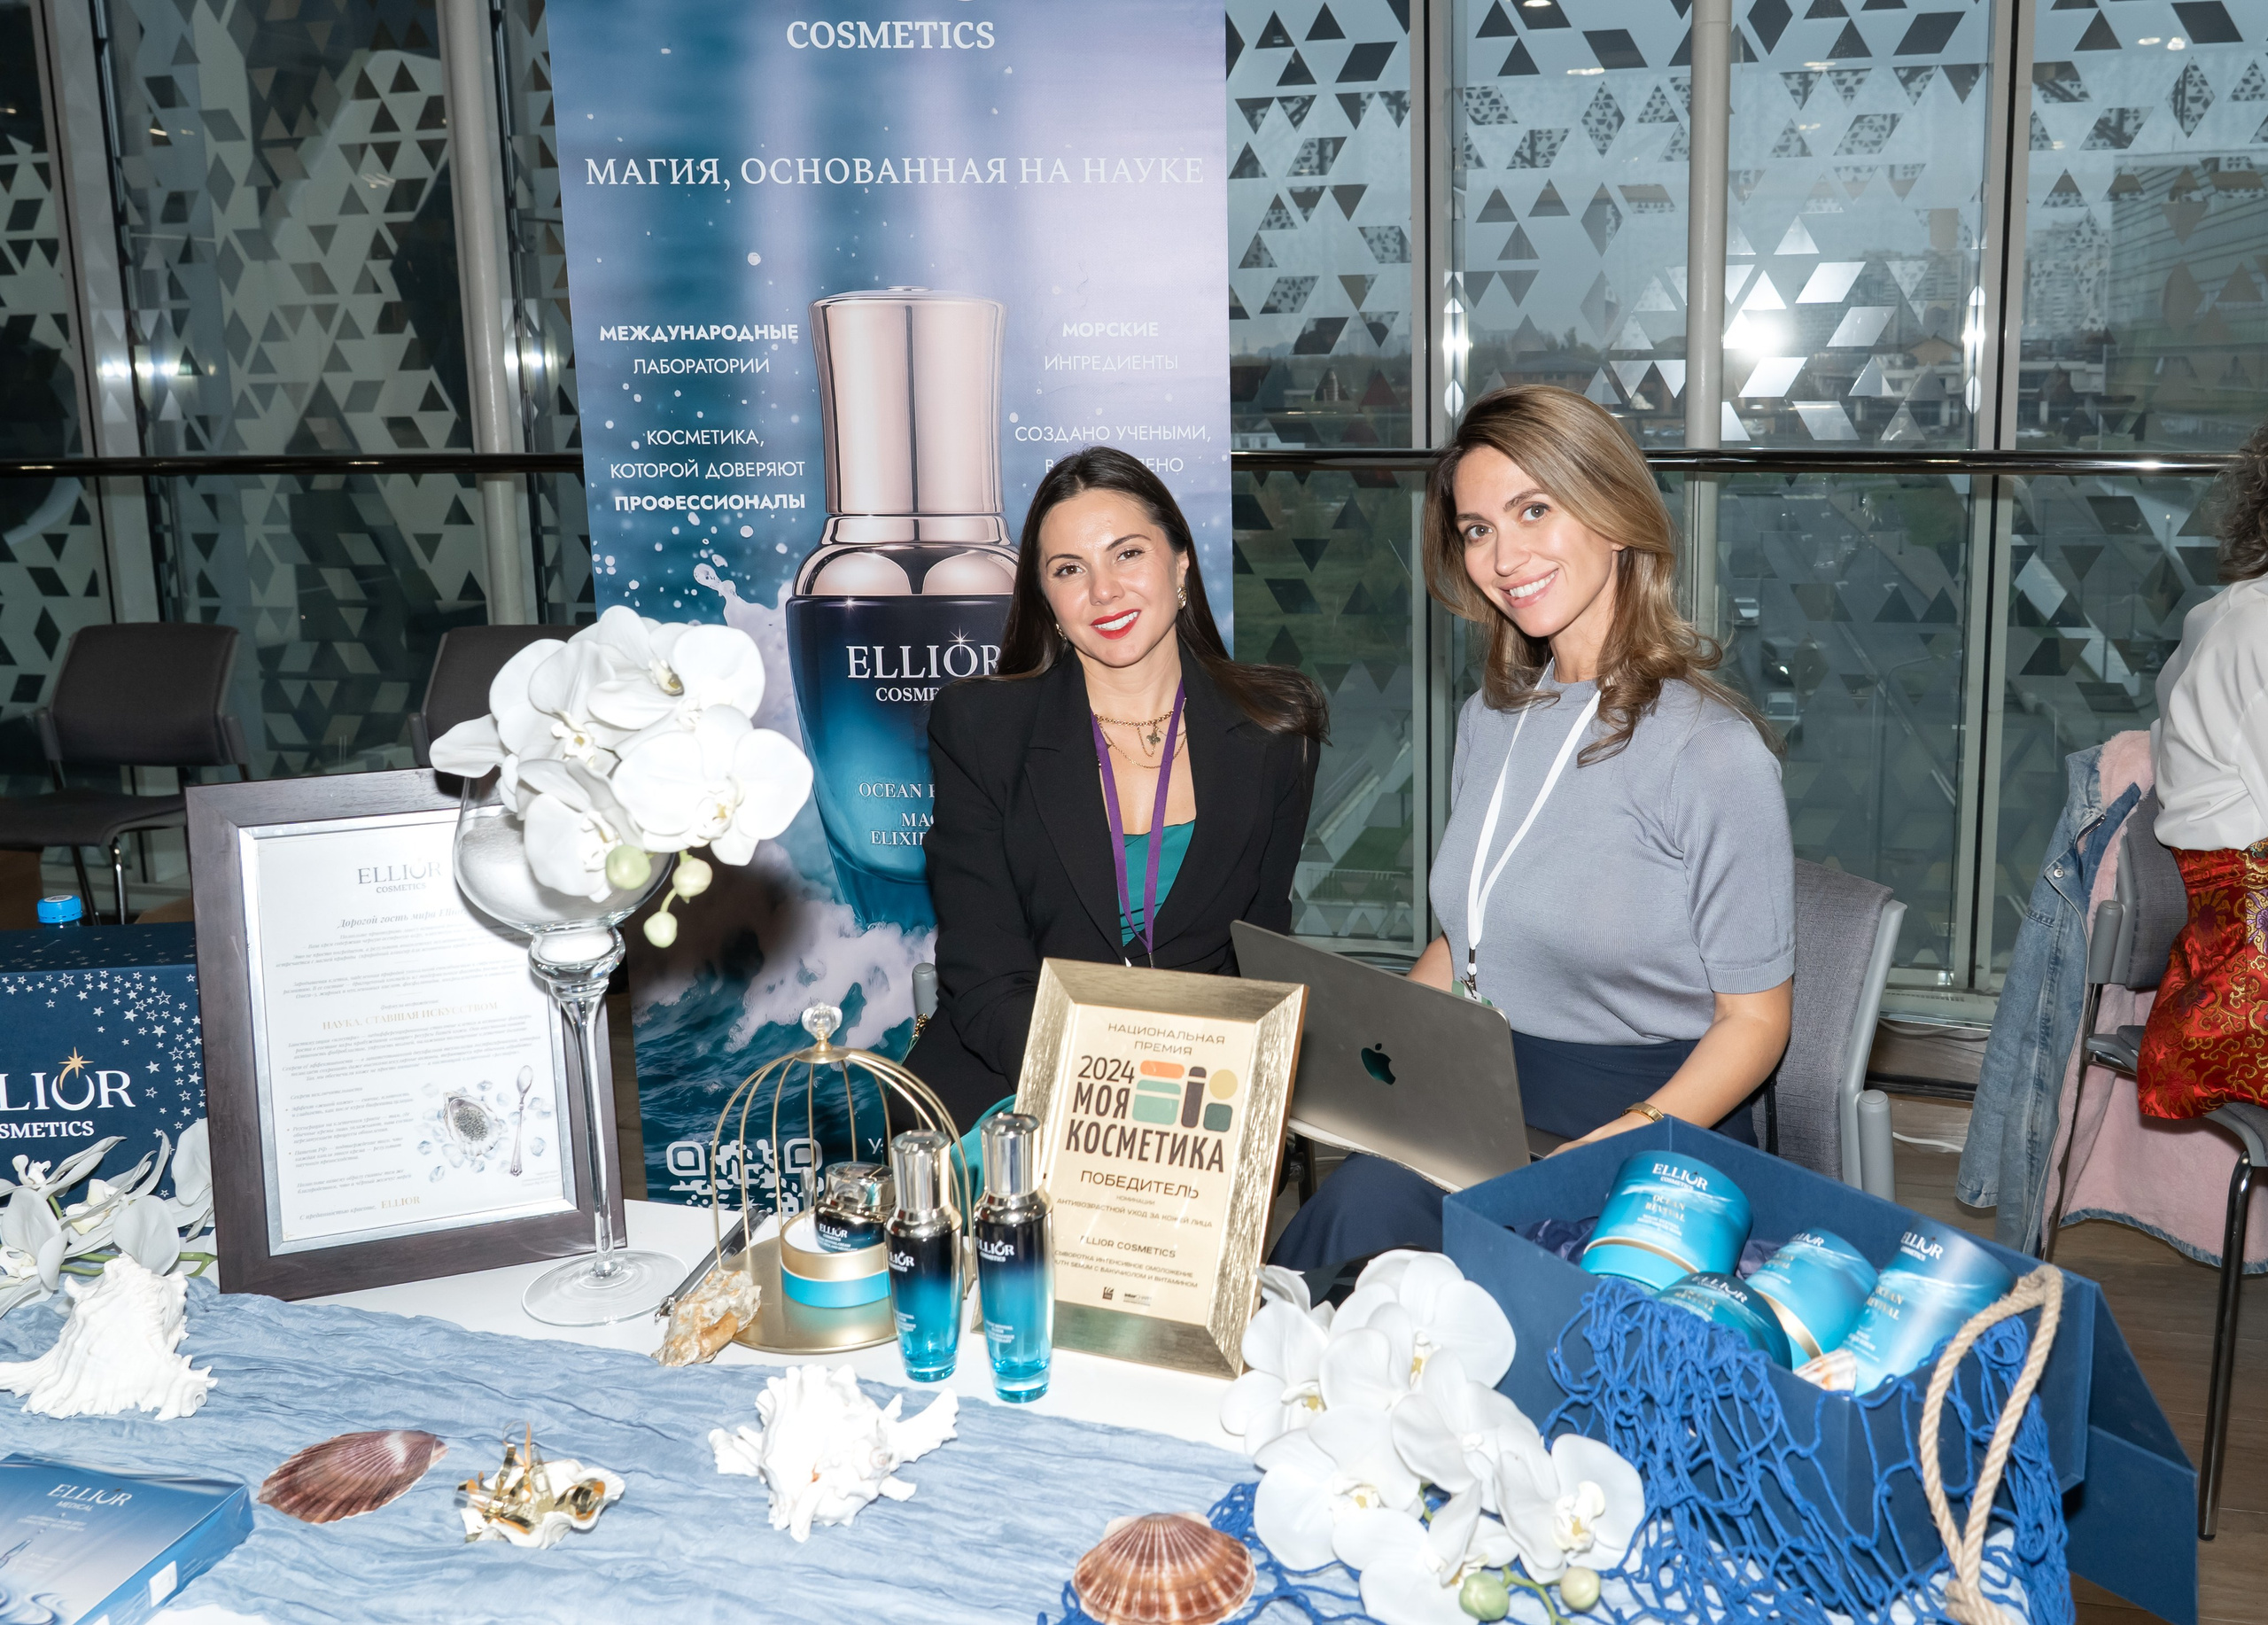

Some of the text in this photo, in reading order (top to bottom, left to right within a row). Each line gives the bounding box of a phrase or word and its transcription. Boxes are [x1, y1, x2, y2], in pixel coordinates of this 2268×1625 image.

[787, 20, 995, 49] COSMETICS
[585, 158, 1204, 191] МАГИЯ, ОСНОВАННАЯ НА НАУКЕ
[600, 324, 798, 343] МЕЖДУНАРОДНЫЕ
[1062, 322, 1159, 338] МОРСКИЕ
[633, 358, 770, 374] ЛАБОРАТОРИИ
[1045, 355, 1178, 371] ИНГРЕДИЕНТЫ
[647, 429, 764, 447] КОСМЕТИКА,
[1015, 425, 1211, 443] СОЗДАНО УЧЕНЫМИ,
[610, 459, 805, 479] КОТОРОЙ ДОВЕРЯЮТ
[615, 494, 805, 511] ПРОФЕССИОНАЛЫ
[846, 644, 1001, 679] ELLIOR
[875, 688, 943, 702] COSME
[858, 782, 922, 798] OCEAN
[901, 812, 935, 827] MA
[358, 861, 441, 884] ELLIOR
[376, 882, 426, 894] COSMETICS
[337, 914, 377, 929] Дорогой
[380, 913, 408, 923] гость
[365, 1011, 419, 1025] СТАВШАЯ
[422, 1001, 498, 1019] ИСКУССТВОМ
[1108, 1023, 1225, 1045] НАЦИОНАЛЬНАЯ
[1134, 1040, 1192, 1055] ПРЕМИЯ
[1078, 1055, 1135, 1084] 2024
[1072, 1082, 1130, 1119] МОЯ
[1065, 1119, 1223, 1173] КОСМЕТИКА
[1080, 1170, 1199, 1199] ПОБЕДИТЕЛЬ
[1652, 1162, 1708, 1191] ELLIOR
[381, 1195, 419, 1208] ELLIOR
[1057, 1198, 1125, 1215] АНТИВОЗРАСТНОЙ
[1128, 1209, 1147, 1218] УХОД
[1191, 1218, 1212, 1228] ЛИЦА
[819, 1223, 848, 1238] ELLIOR
[1117, 1241, 1176, 1258] COSMETICS
[1900, 1232, 1944, 1260] ELLIOR
[47, 1483, 133, 1506] ELLIOR
[56, 1500, 94, 1512] MEDICAL
